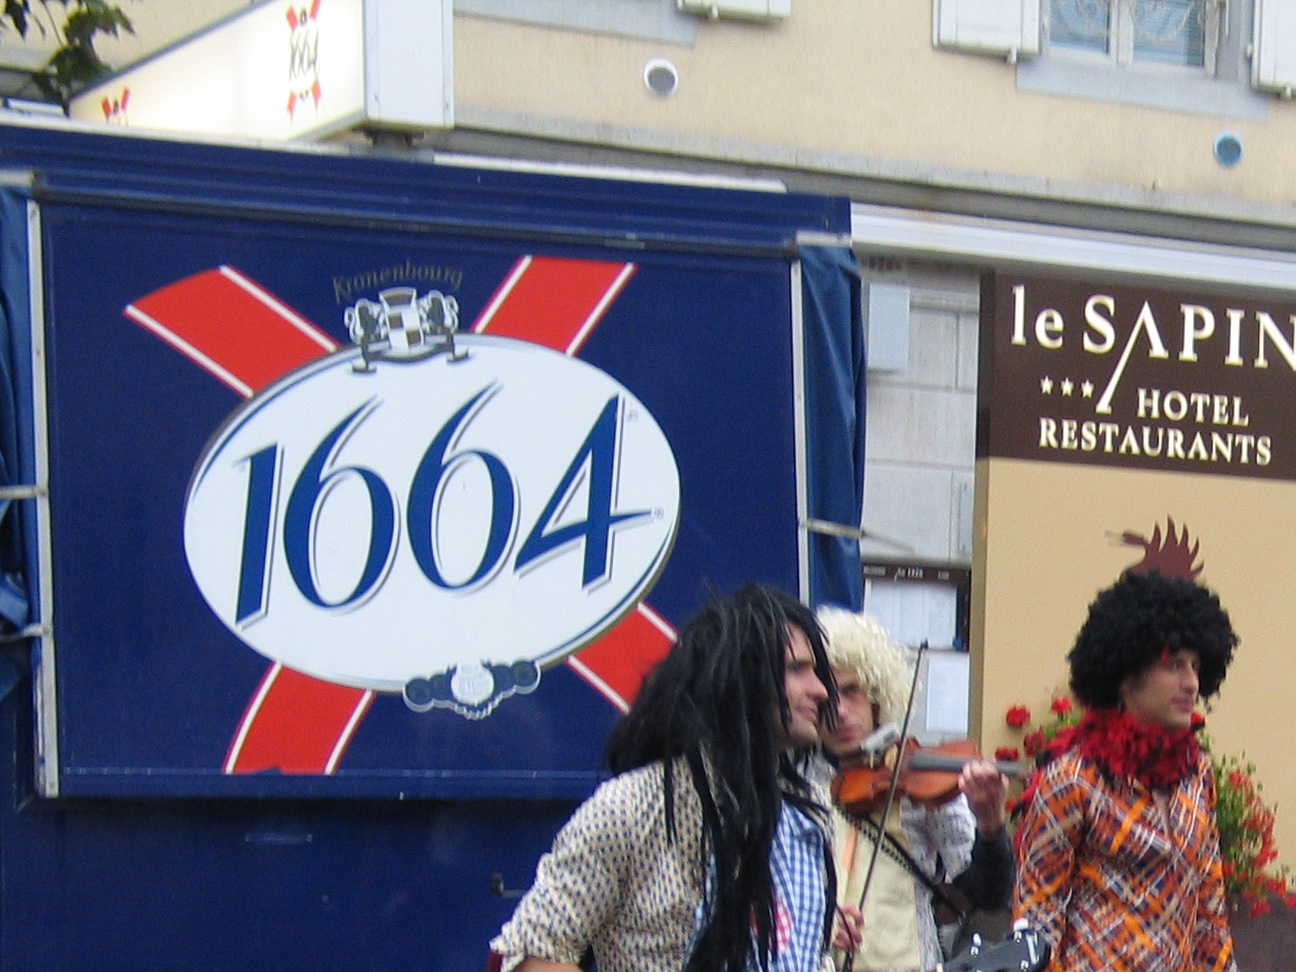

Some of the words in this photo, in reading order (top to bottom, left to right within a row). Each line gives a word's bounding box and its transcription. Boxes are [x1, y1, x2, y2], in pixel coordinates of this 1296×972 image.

[333, 259, 463, 304] Kronenbourg
[1010, 284, 1064, 350] le
[1137, 386, 1250, 427] HOTEL
[1038, 416, 1273, 467] RESTAURANTS
[233, 380, 654, 631] 1664
